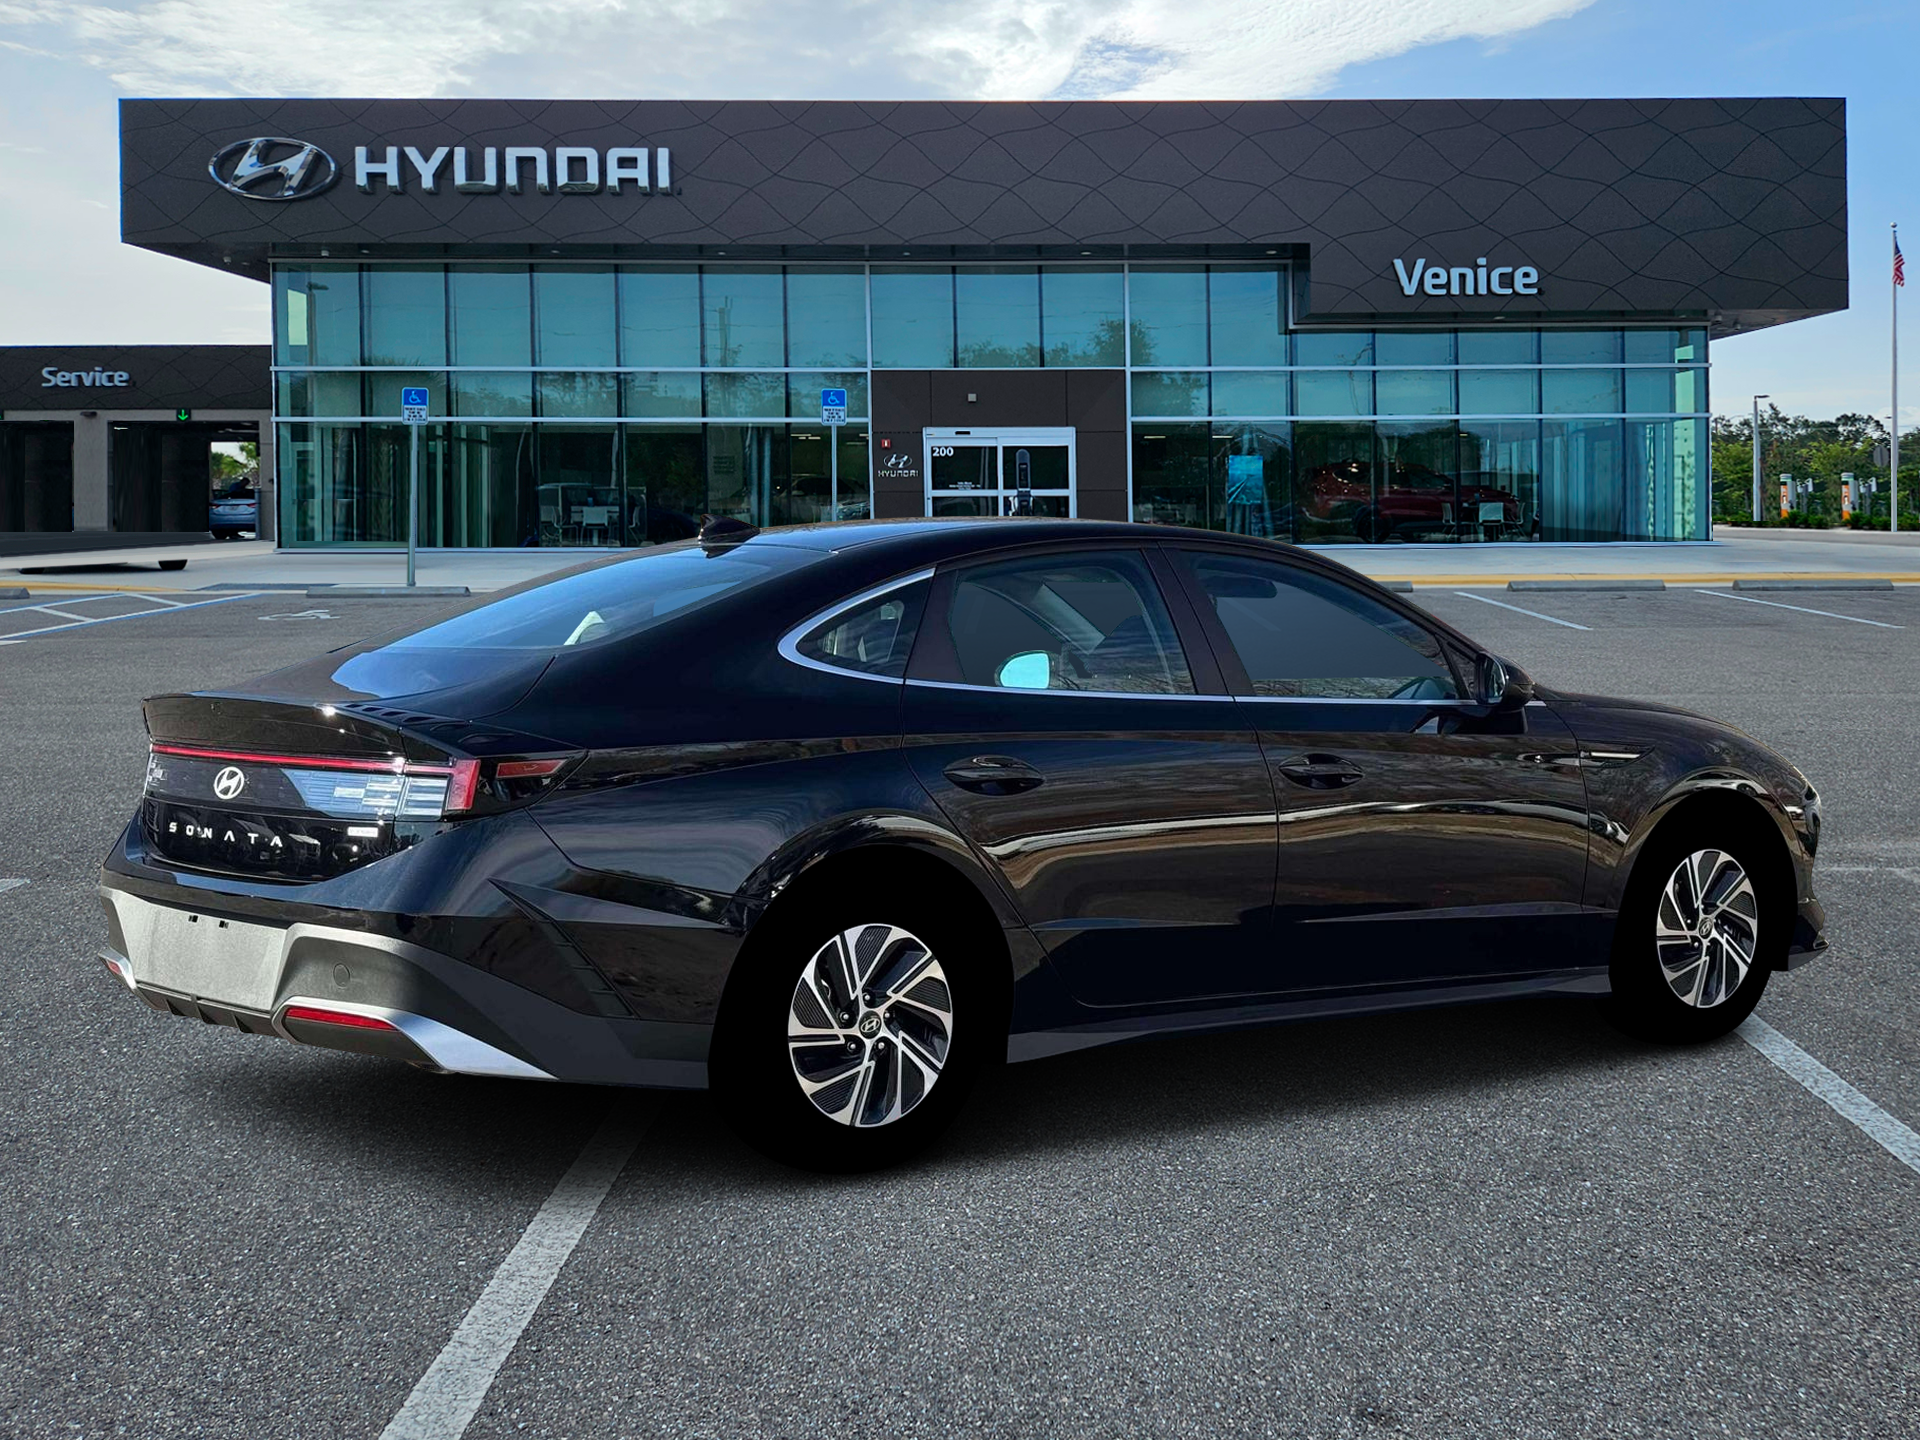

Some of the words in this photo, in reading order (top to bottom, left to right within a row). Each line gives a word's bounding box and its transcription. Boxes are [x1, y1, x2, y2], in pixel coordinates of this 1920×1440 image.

[354, 146, 672, 193] HYUNDAI
[1392, 257, 1539, 295] Venice
[41, 366, 130, 387] Service
[932, 446, 954, 457] 200
[877, 469, 919, 478] HYUNDAI
[168, 821, 283, 848] SONATA
